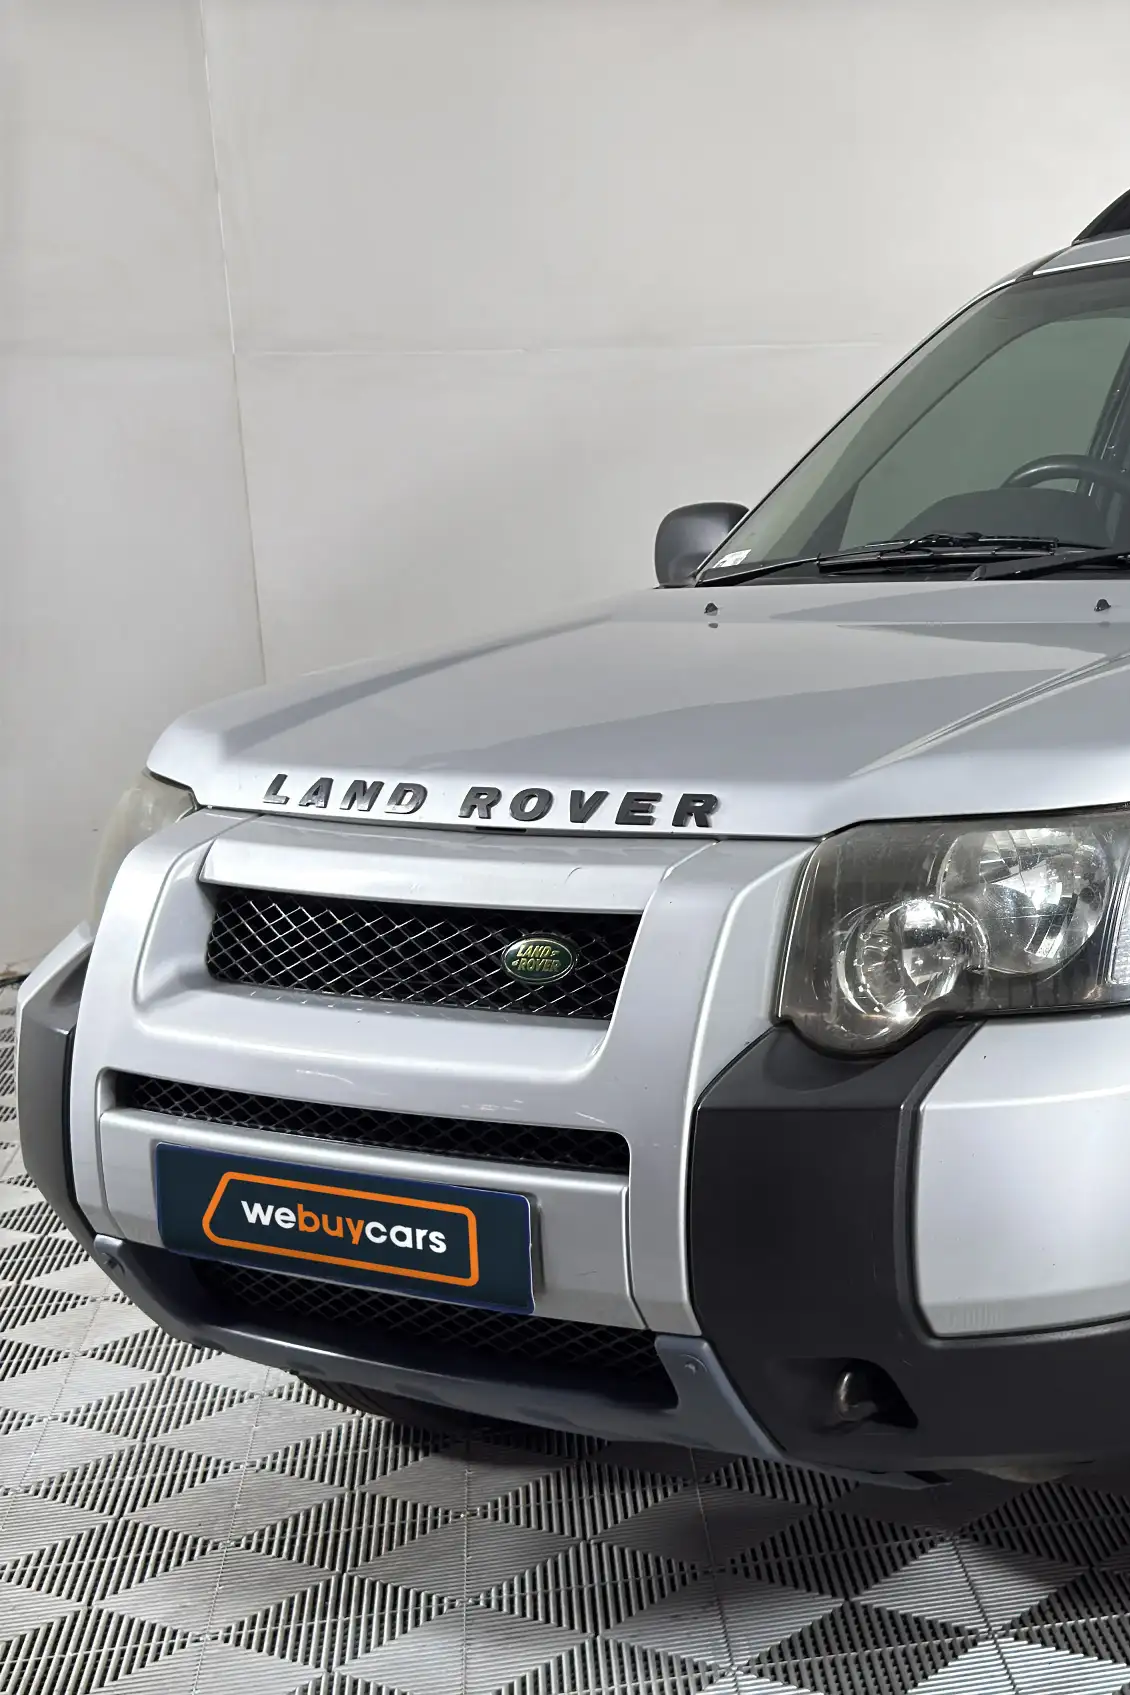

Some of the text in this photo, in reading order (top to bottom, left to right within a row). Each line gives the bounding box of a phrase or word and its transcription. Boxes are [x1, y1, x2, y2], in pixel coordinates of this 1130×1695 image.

[263, 773, 722, 828] LAND ROVER
[517, 944, 552, 957] LAND
[517, 958, 561, 972] ROVER
[240, 1200, 448, 1254] webuycars
